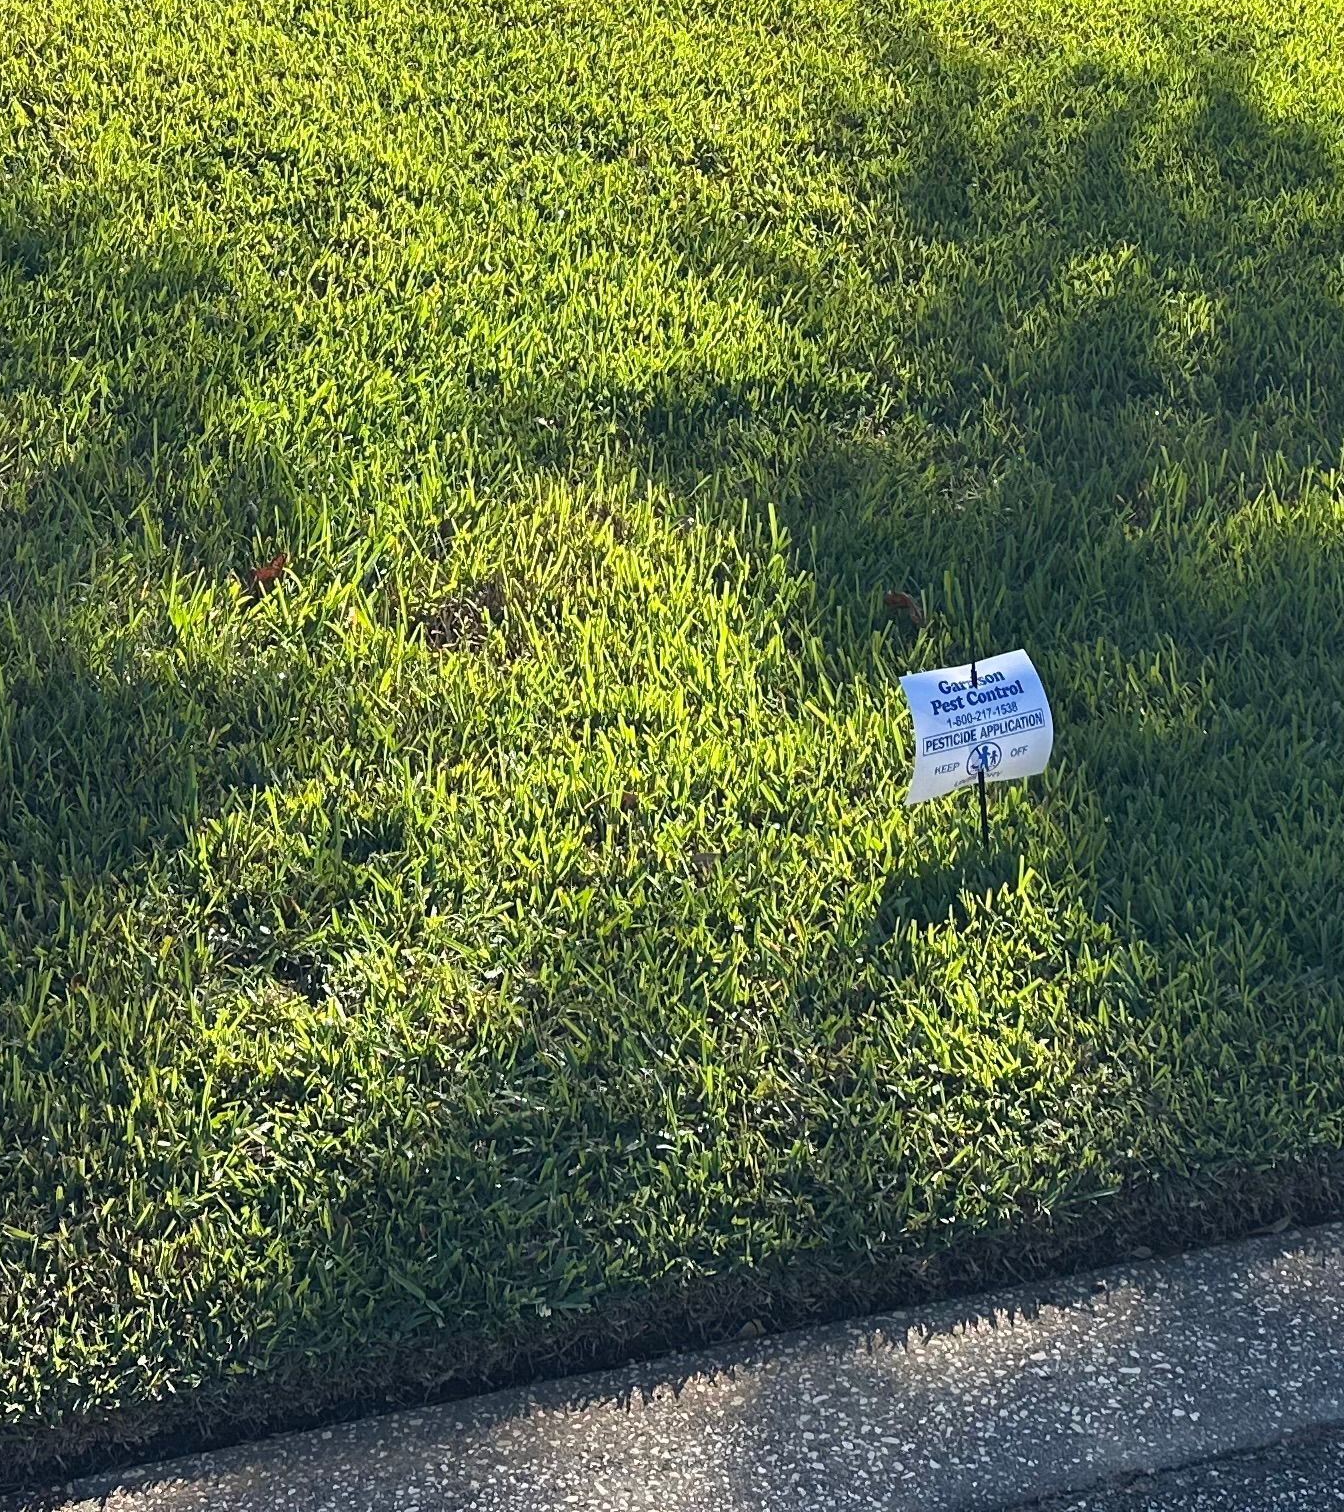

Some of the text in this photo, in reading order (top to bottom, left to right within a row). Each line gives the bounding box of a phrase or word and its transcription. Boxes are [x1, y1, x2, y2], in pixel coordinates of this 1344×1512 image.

[930, 680, 1024, 715] Pest Control
[938, 671, 1005, 694] Garson
[925, 712, 1044, 752] PESTICIDE APPLICATION
[934, 745, 1029, 775] KEEP OFF
